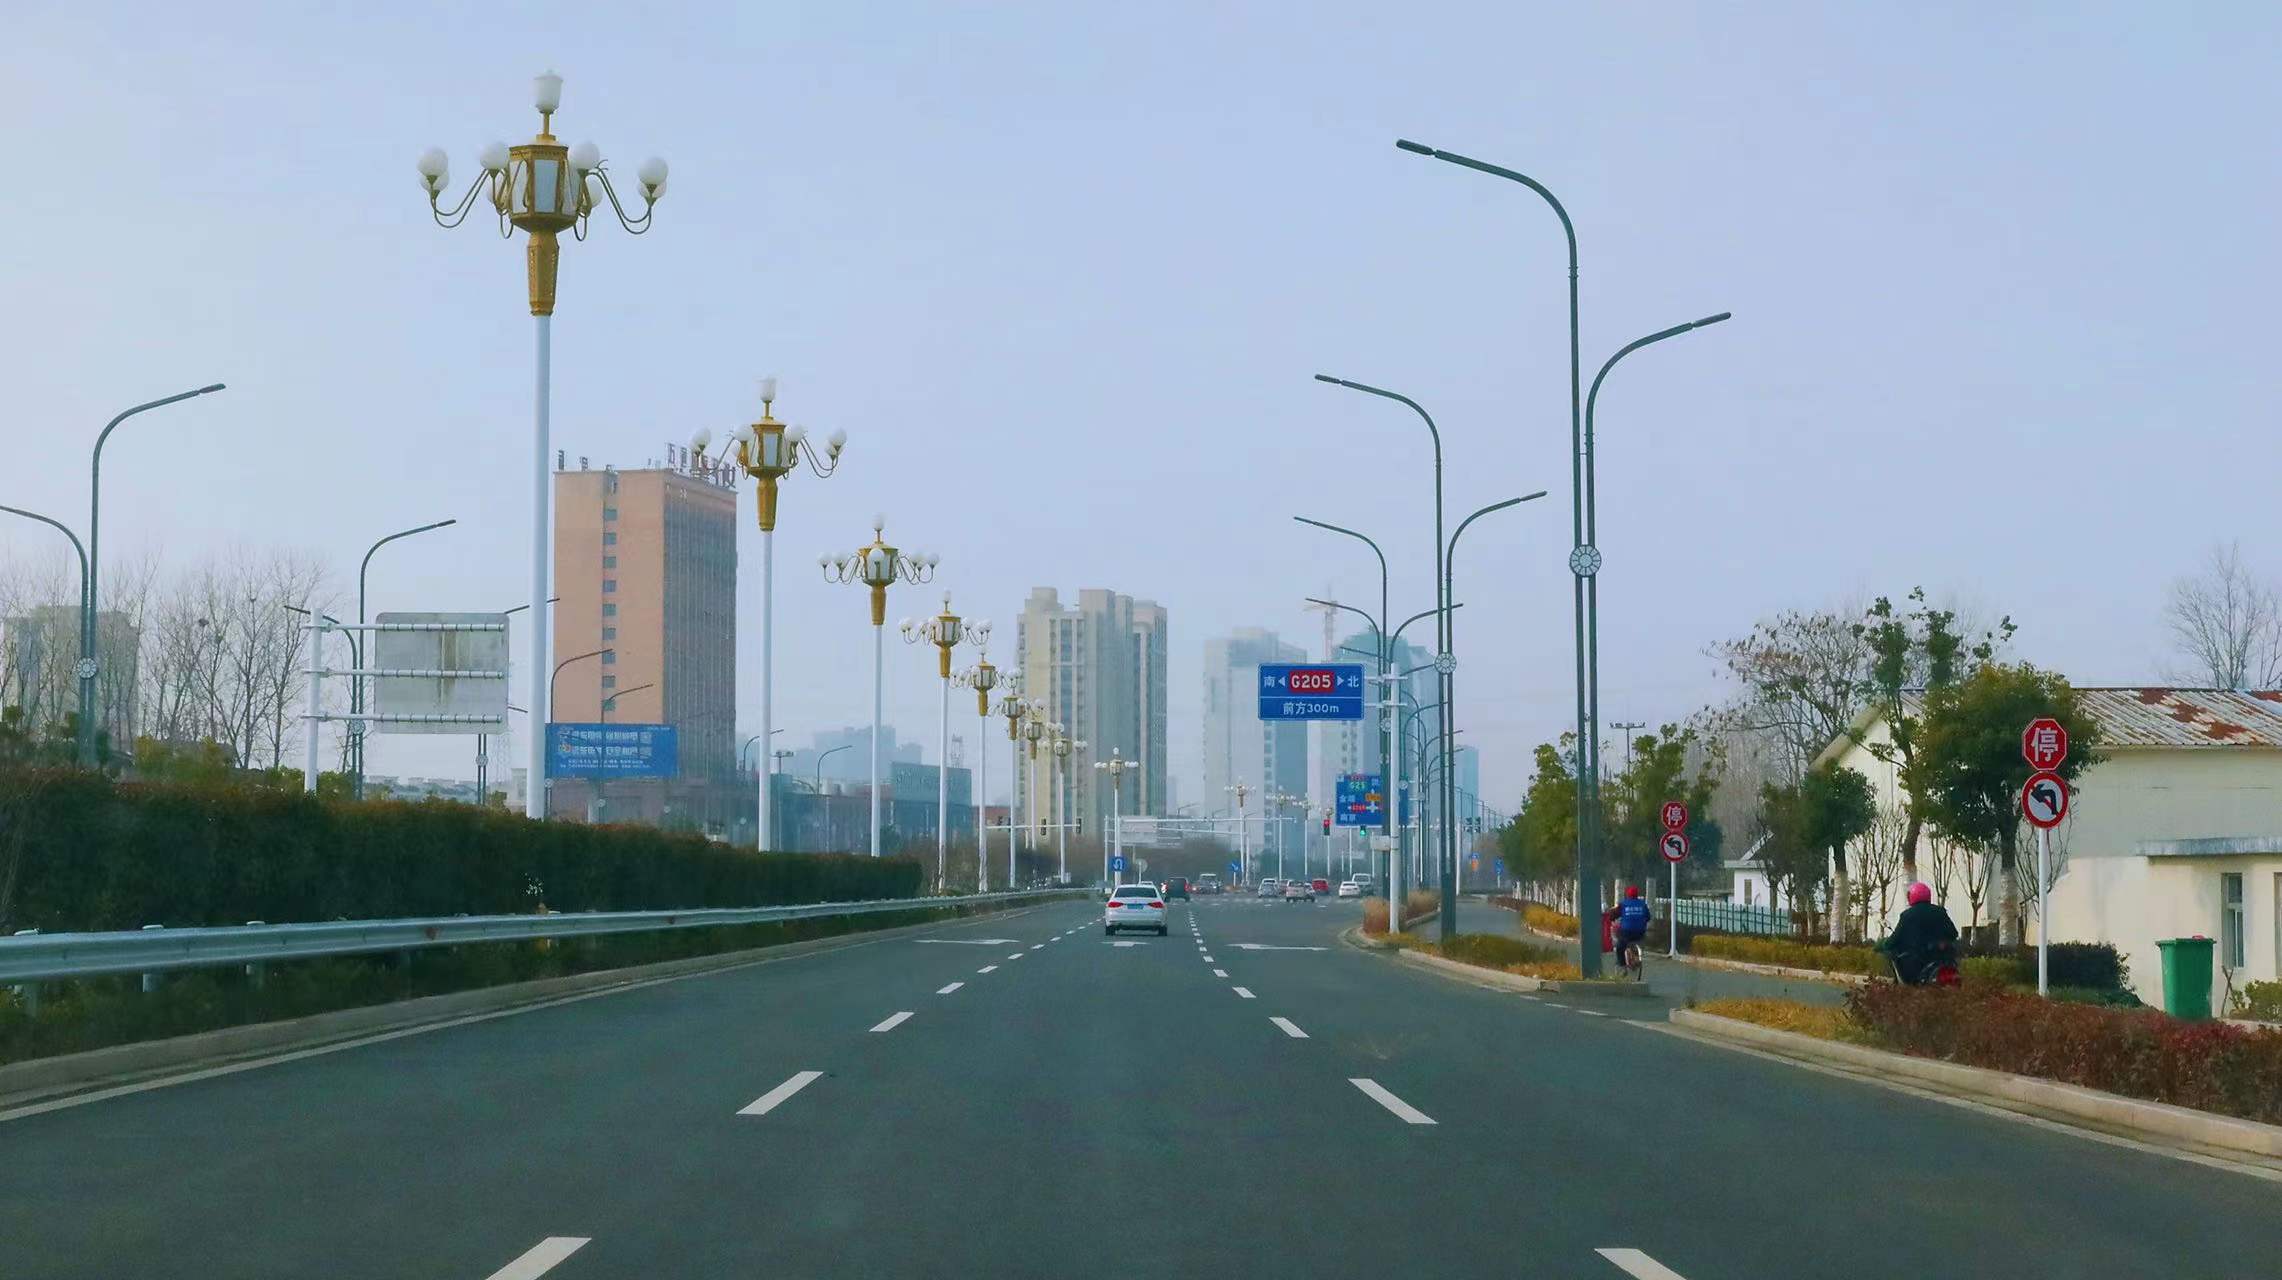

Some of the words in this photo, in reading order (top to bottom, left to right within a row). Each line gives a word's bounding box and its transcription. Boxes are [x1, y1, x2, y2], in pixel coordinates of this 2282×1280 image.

[1263, 675, 1275, 688] 南
[1291, 674, 1331, 688] G205
[1347, 675, 1359, 687] 北
[1283, 702, 1339, 715] 前方300m
[2030, 727, 2058, 762] 停
[1667, 806, 1682, 825] 停
